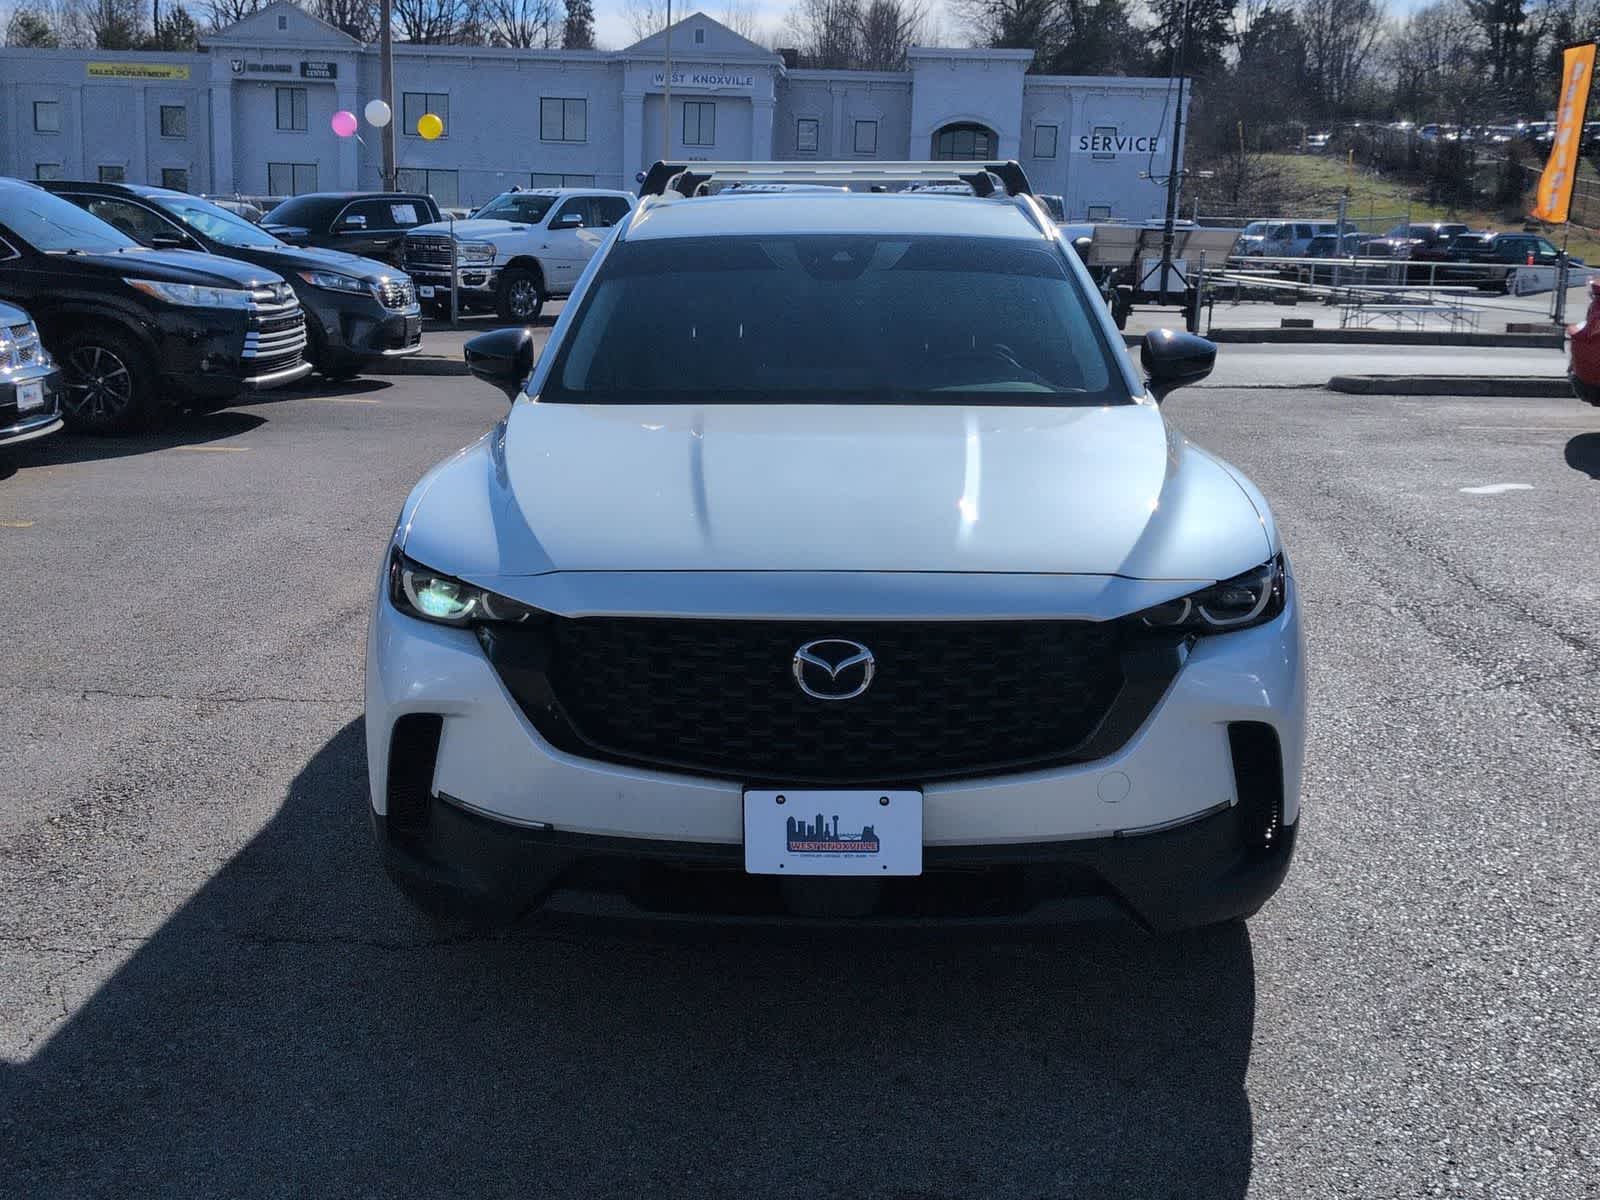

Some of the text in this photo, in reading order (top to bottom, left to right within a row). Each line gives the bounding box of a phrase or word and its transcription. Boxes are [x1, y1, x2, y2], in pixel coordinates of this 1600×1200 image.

[89, 68, 171, 78] SALES DEPARTMENT
[655, 72, 753, 86] WST KNOXVILLE
[1079, 135, 1158, 152] SERVICE
[792, 842, 876, 850] WEST KNOXVILLE
